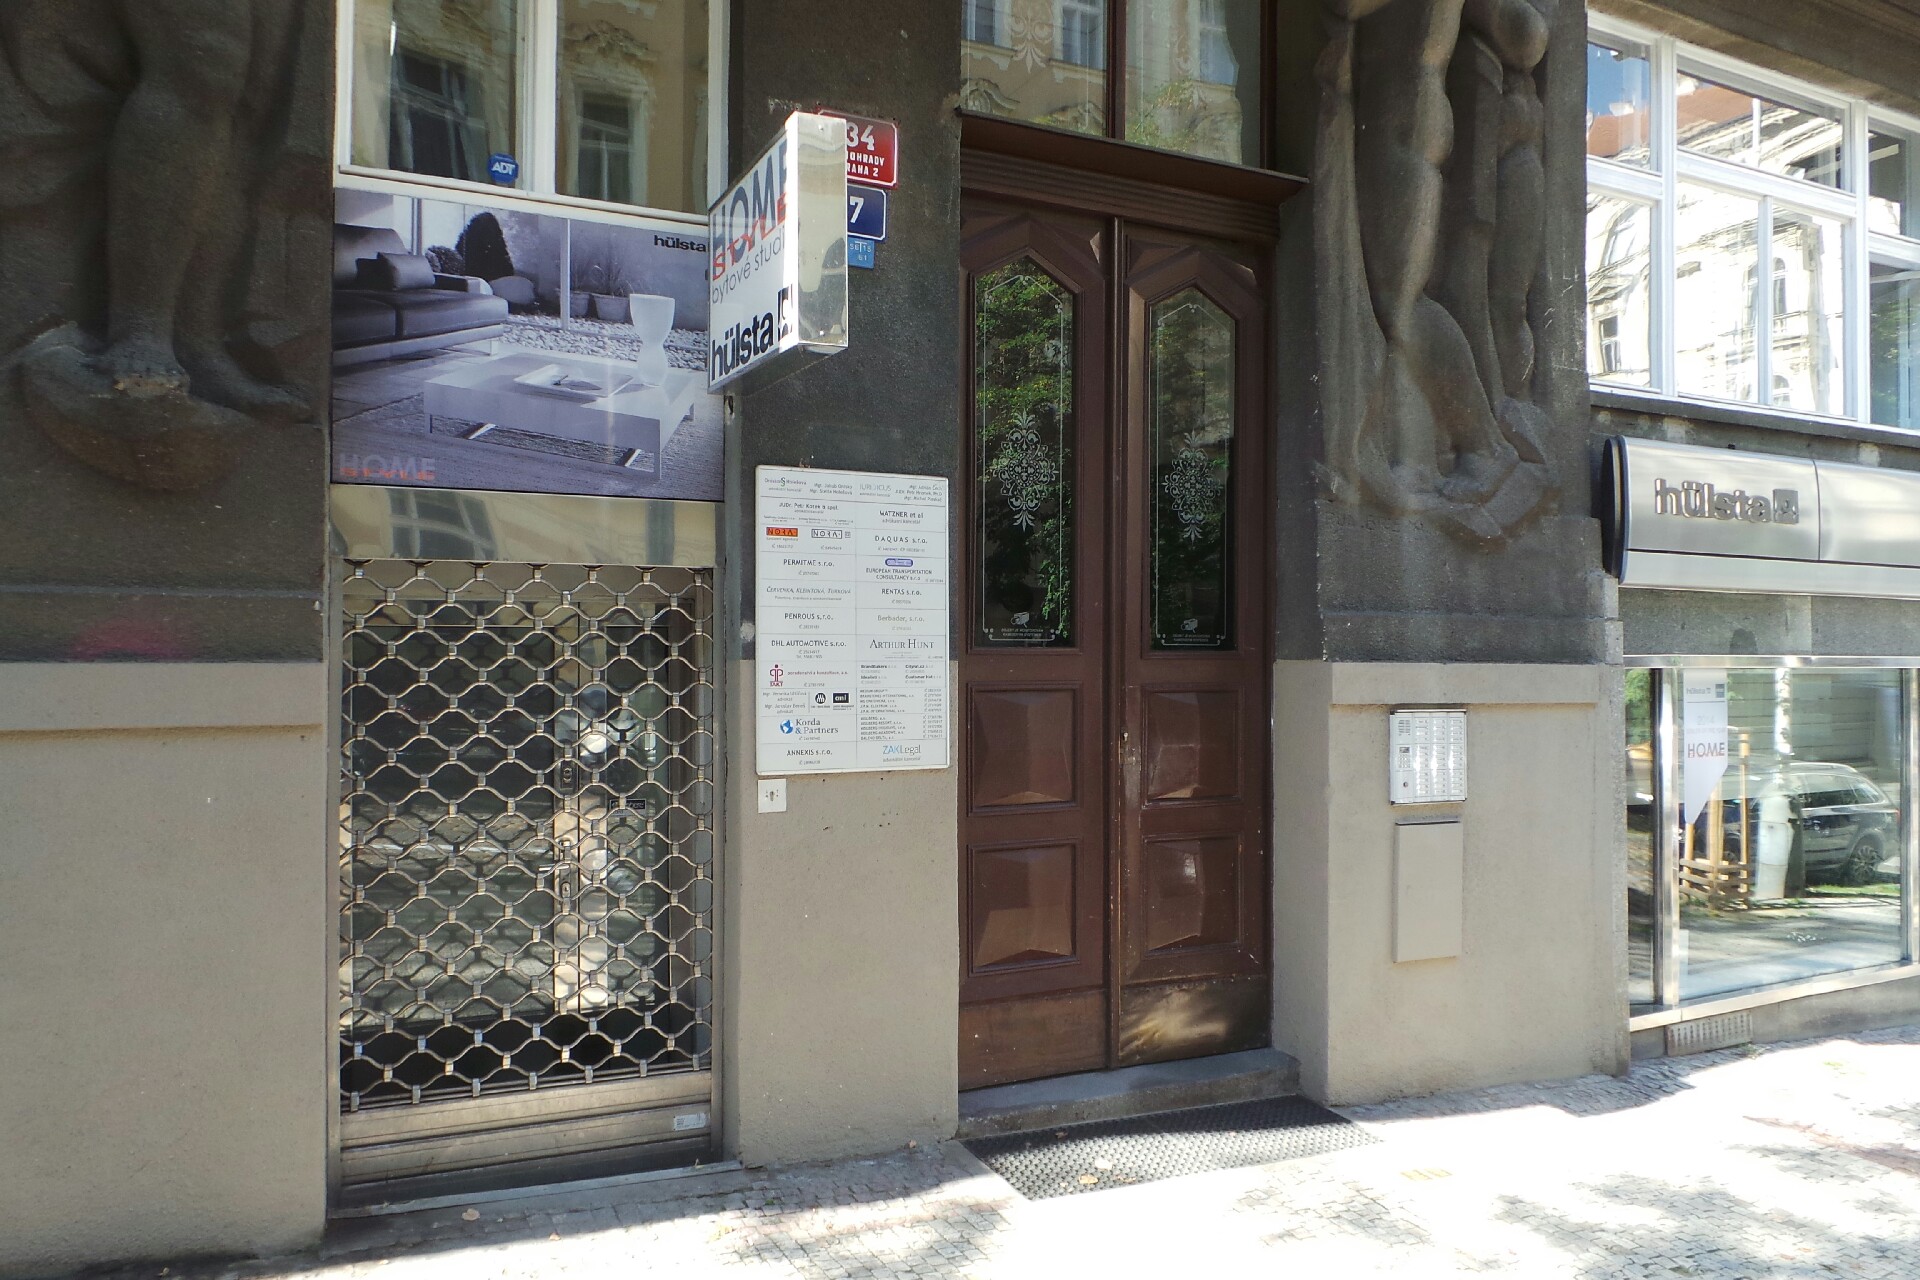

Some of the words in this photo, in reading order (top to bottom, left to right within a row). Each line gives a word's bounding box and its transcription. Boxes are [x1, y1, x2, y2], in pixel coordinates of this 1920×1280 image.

[846, 150, 885, 167] OHRADY
[491, 161, 516, 176] ADT
[872, 167, 879, 177] 2
[849, 195, 865, 224] 7
[654, 234, 707, 252] hülsta
[712, 192, 787, 282] STYLE
[711, 254, 751, 305] bytové
[711, 311, 774, 381] hülsta
[340, 454, 436, 479] HOME
[1654, 478, 1772, 524] hülsta
[874, 535, 909, 543] DAQUAS
[784, 612, 815, 620] PENROUS
[795, 718, 821, 726] Korda
[803, 726, 839, 734] Partners
[1687, 742, 1725, 758] HOME
